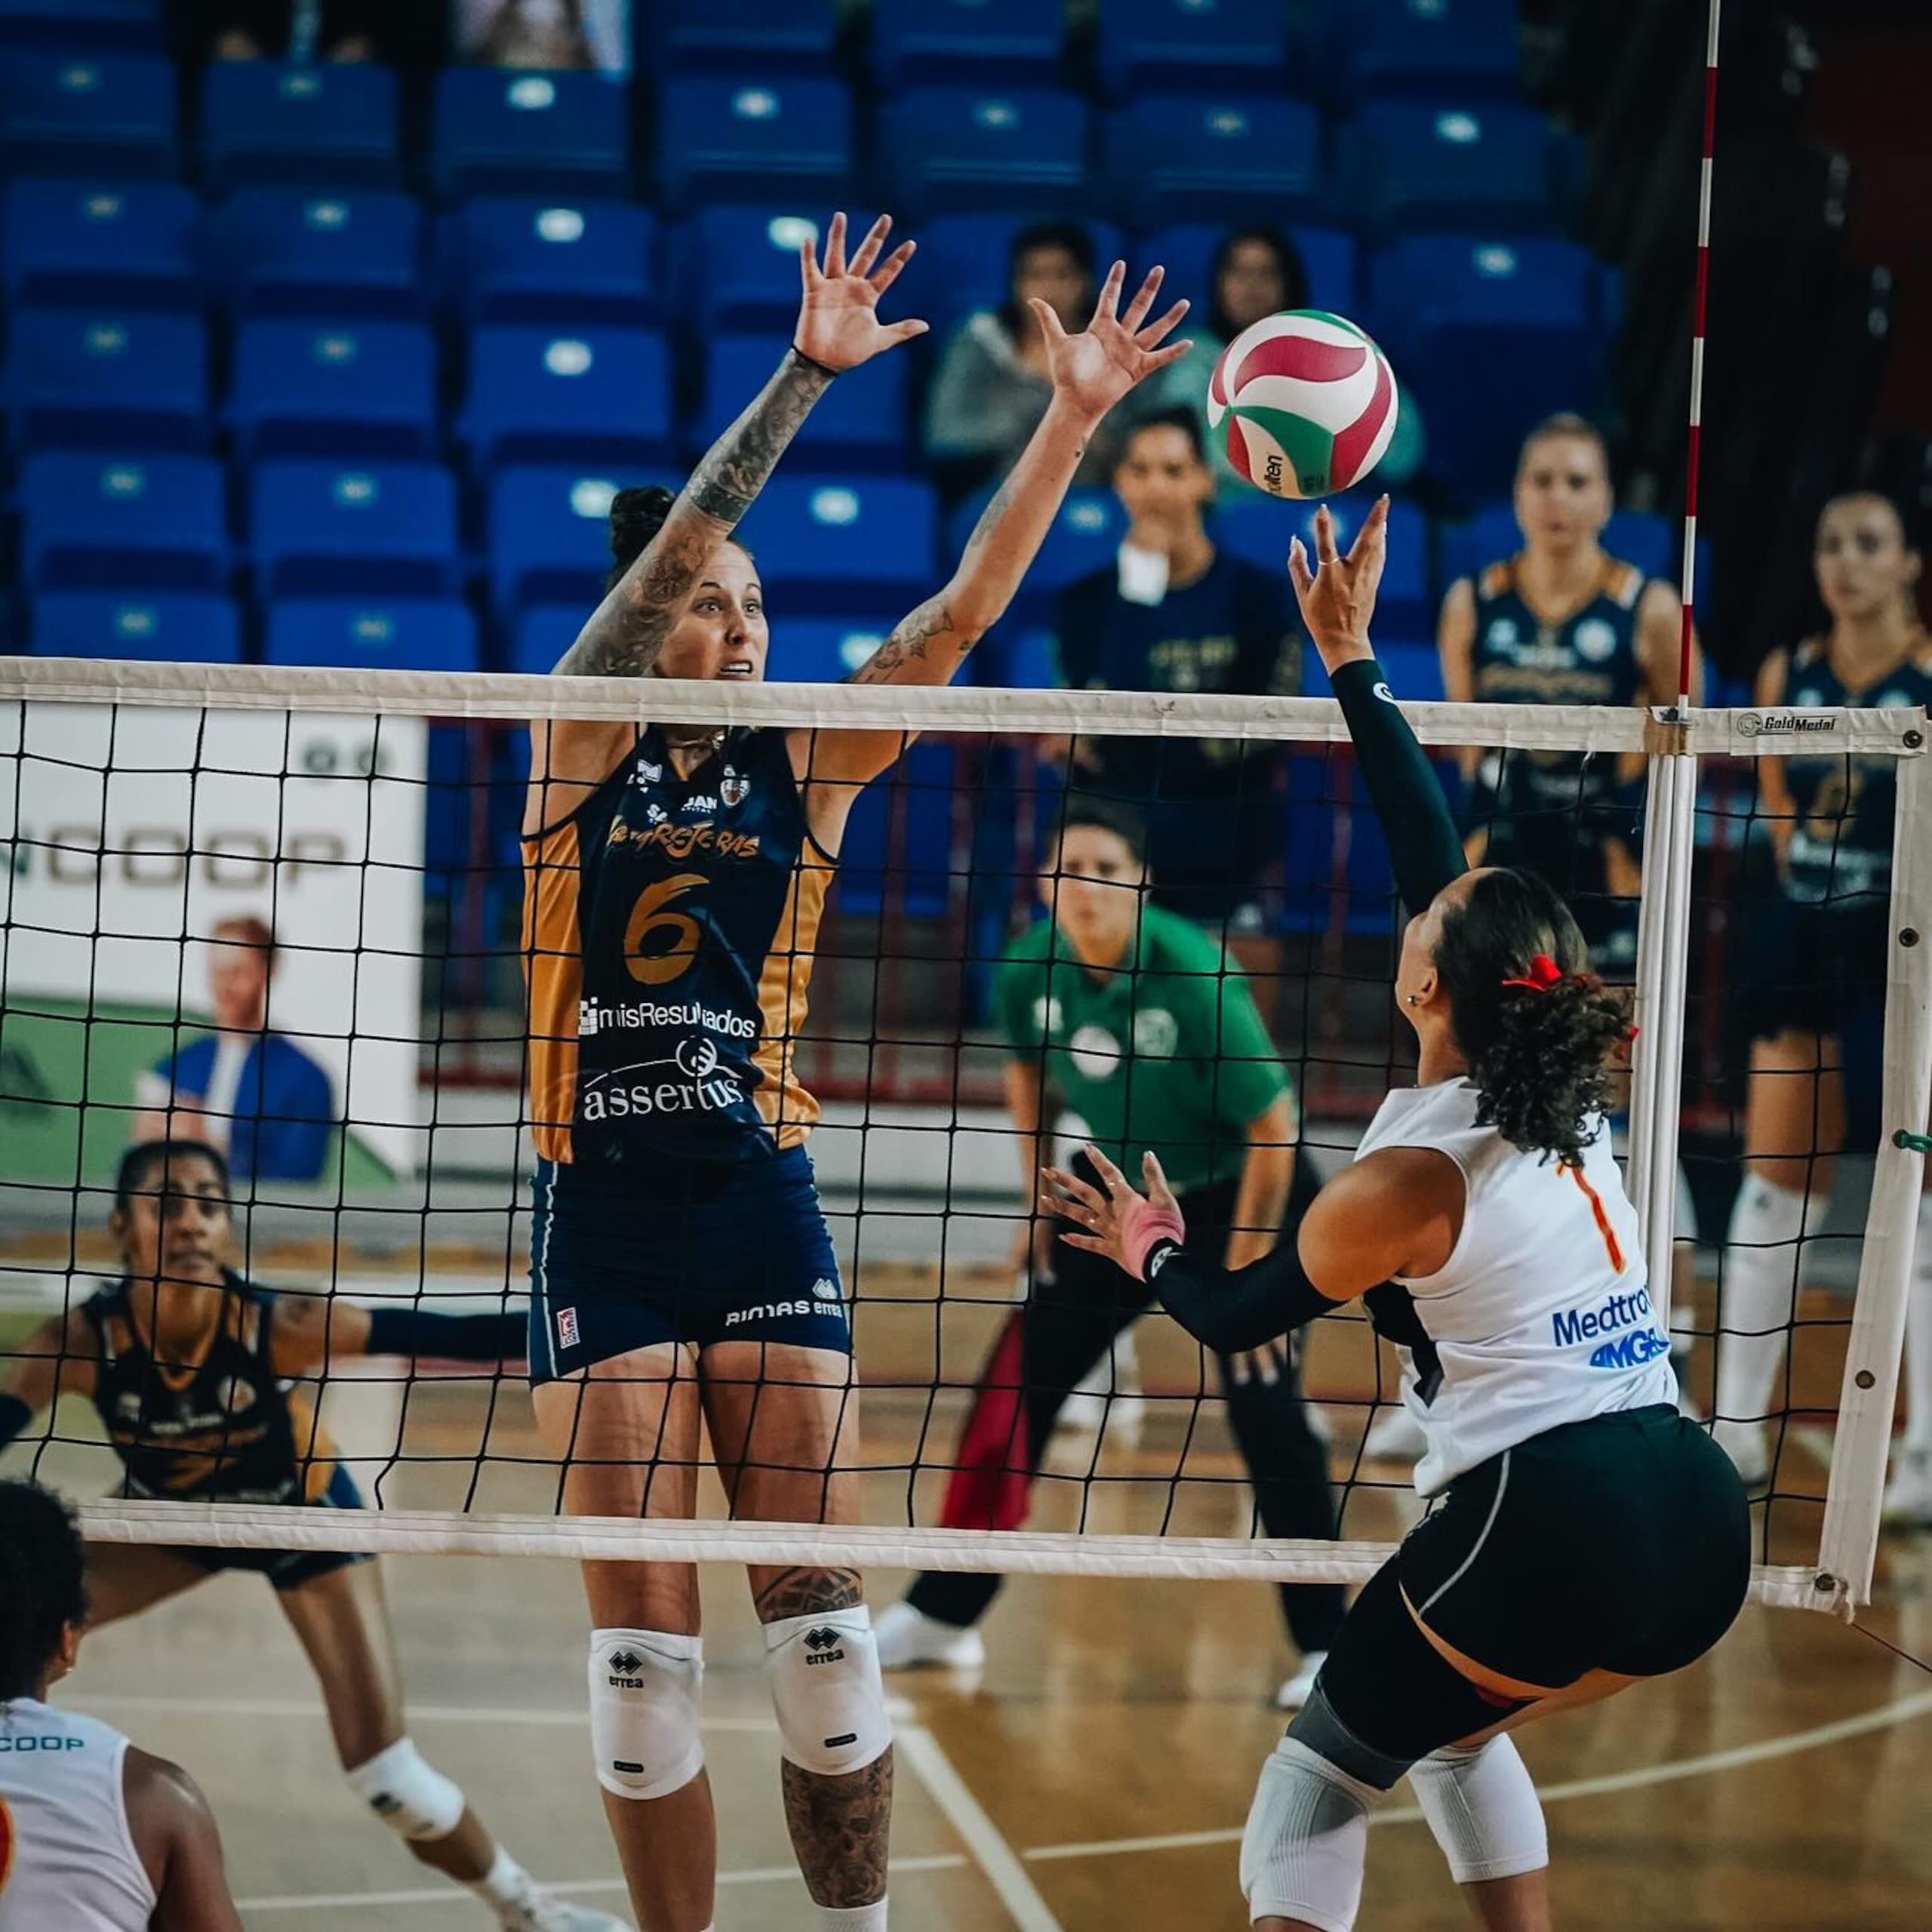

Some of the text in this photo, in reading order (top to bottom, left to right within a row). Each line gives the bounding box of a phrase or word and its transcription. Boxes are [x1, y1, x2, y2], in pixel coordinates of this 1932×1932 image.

[623, 873, 709, 985] 6
[583, 1078, 744, 1121] assertus
[1552, 1285, 1651, 1346] Medtro
[805, 1648, 844, 1666] errea
[608, 1675, 644, 1688] errea
